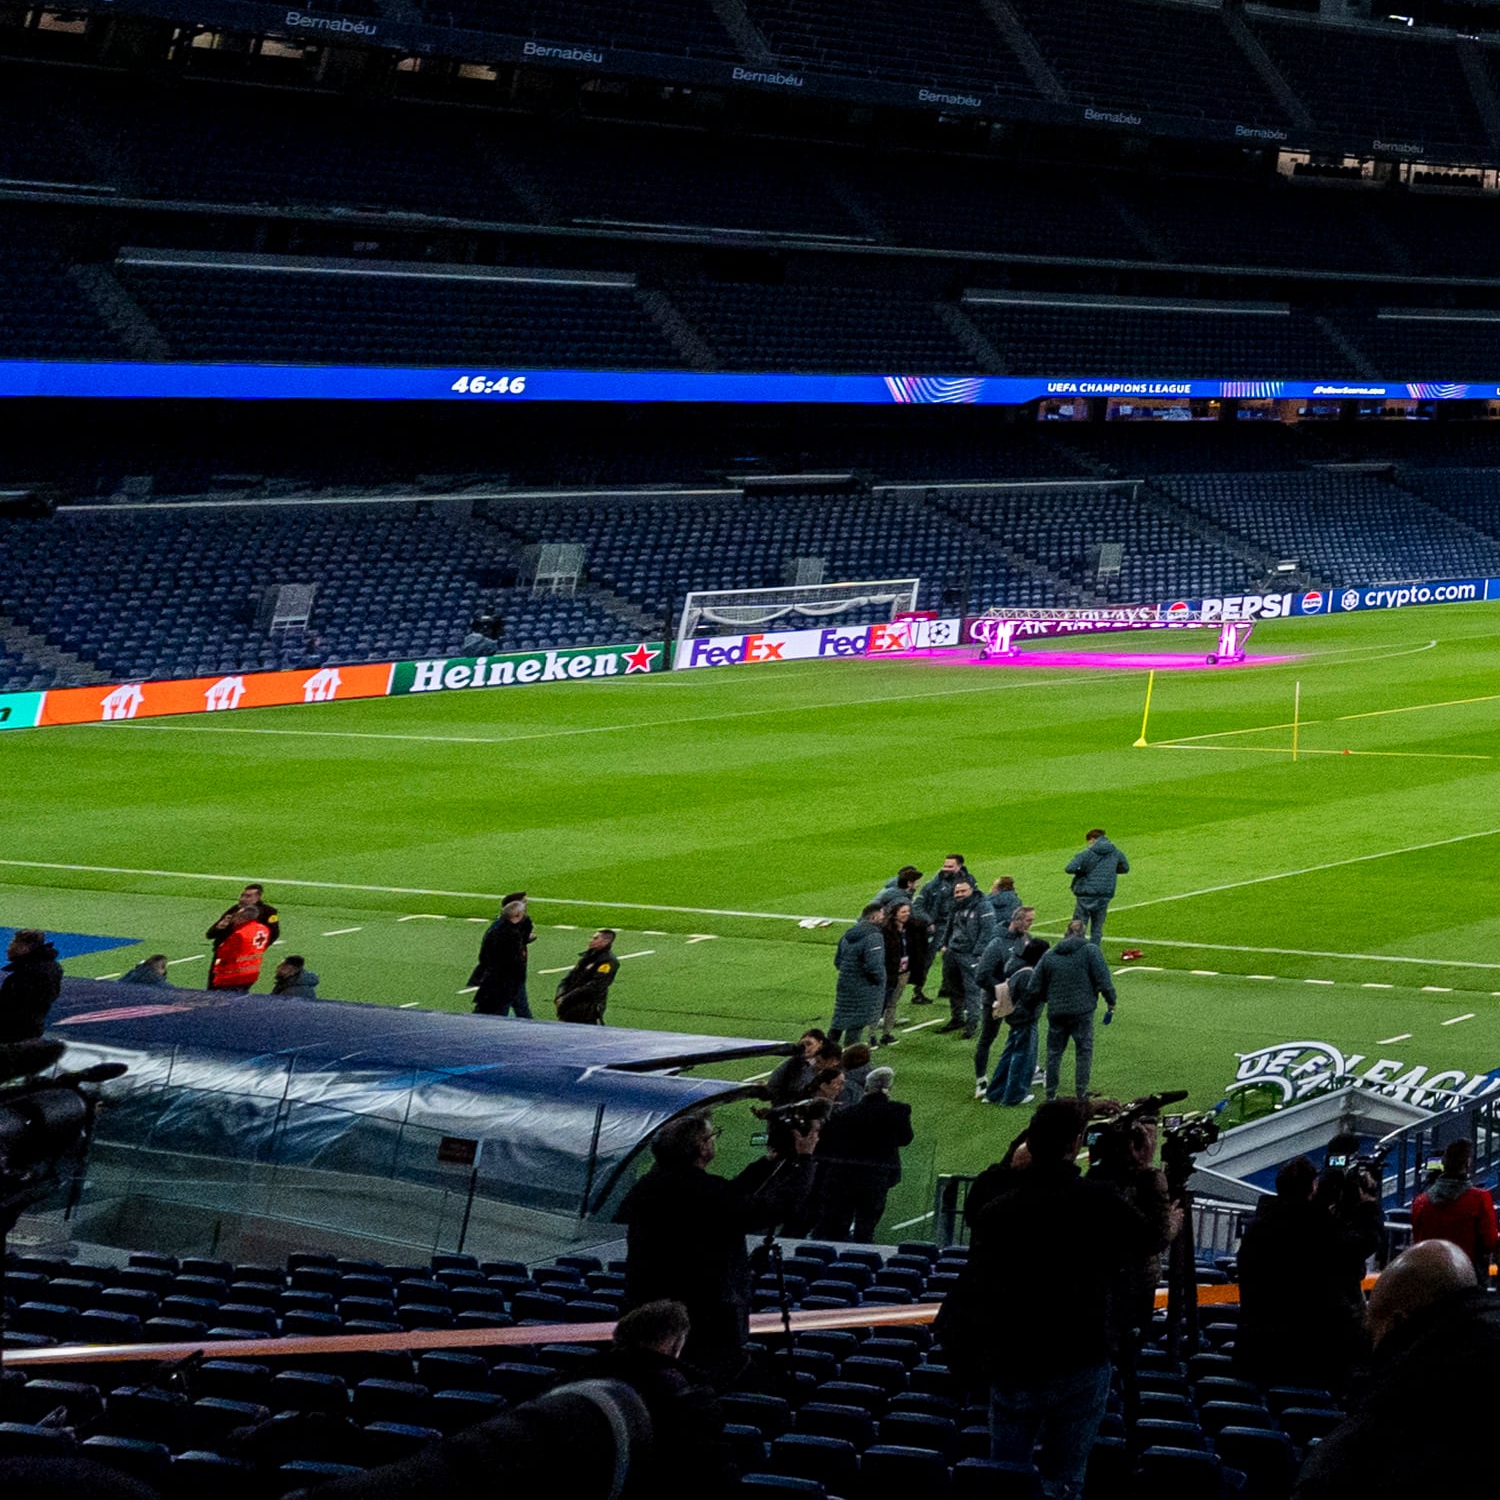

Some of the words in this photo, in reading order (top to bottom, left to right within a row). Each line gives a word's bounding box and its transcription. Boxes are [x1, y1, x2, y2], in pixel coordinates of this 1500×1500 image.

[286, 11, 377, 36] Bernabéu
[523, 42, 603, 63] Bernabéu
[732, 67, 803, 87] Bernabéu
[919, 90, 981, 107] Bernabéu
[1084, 109, 1141, 125] Bernabéu
[1234, 126, 1287, 140] Bernabéu
[1372, 140, 1424, 154] Bernabéu
[451, 376, 526, 394] 46:46
[1047, 383, 1077, 393] UEFA
[1079, 383, 1146, 394] CHAMPIONS
[1149, 384, 1190, 394] LEAGUE
[1365, 583, 1475, 610] crypto.com
[1200, 593, 1292, 622] PEPSI
[819, 625, 908, 656] FedEx
[970, 620, 1048, 642] QAR
[689, 634, 786, 667] FedEx
[410, 652, 618, 693] Heineken
